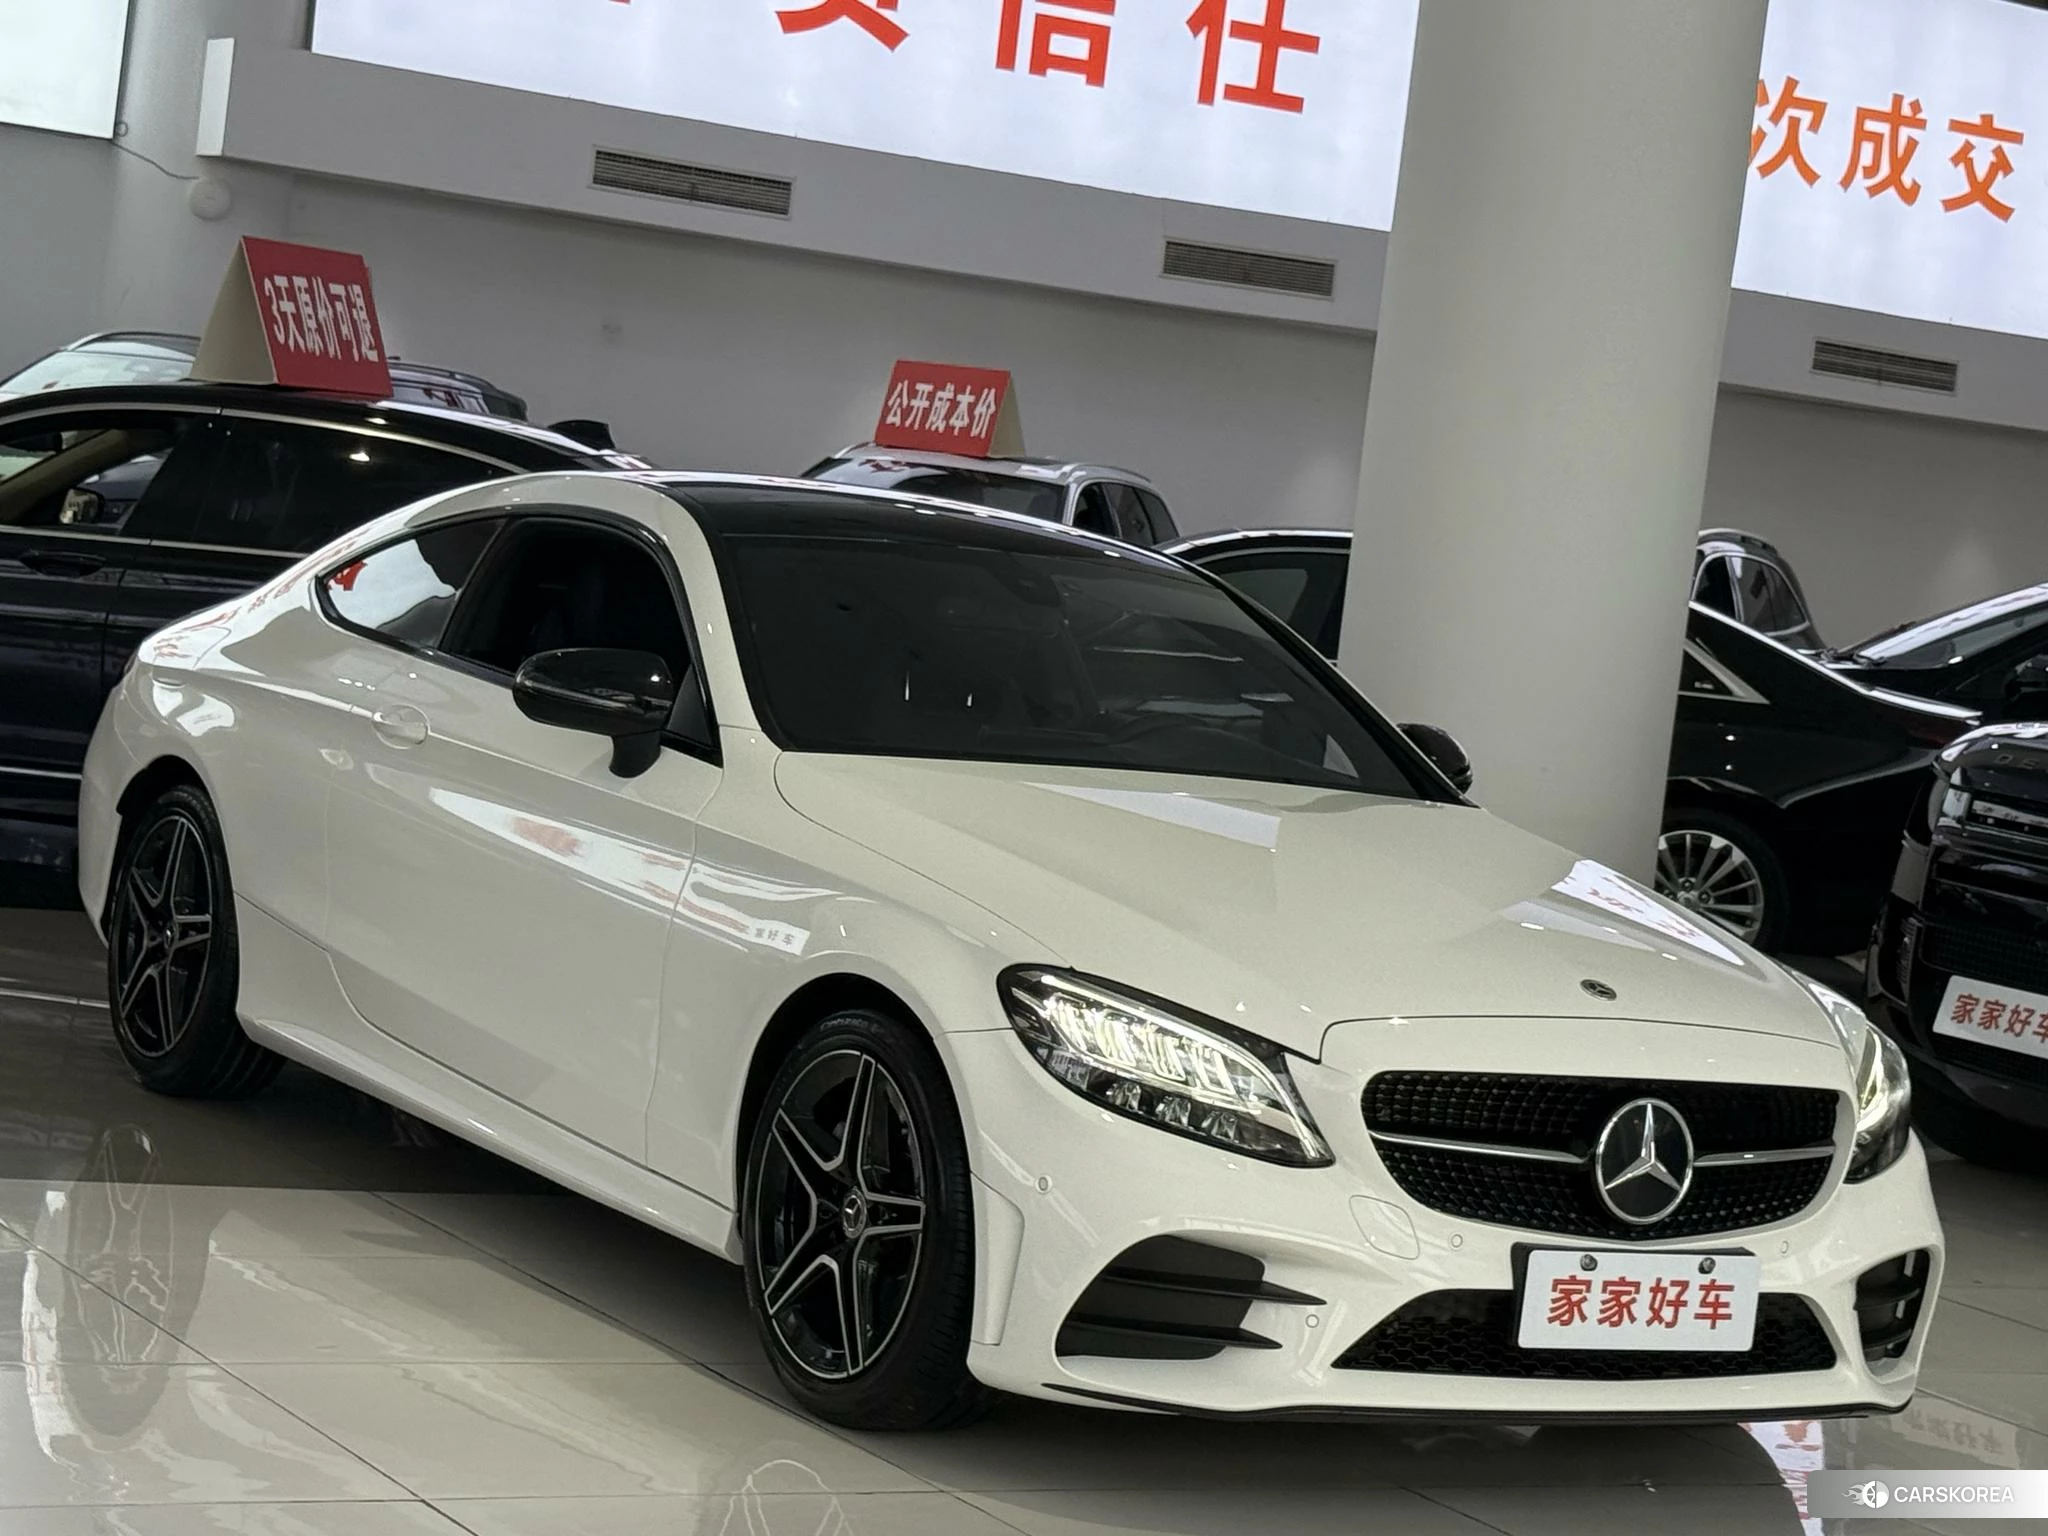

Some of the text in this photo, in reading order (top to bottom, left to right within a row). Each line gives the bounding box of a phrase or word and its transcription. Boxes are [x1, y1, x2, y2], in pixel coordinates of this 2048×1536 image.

[778, 0, 1321, 114] 信任
[1749, 76, 2024, 222] 次成交
[264, 275, 379, 362] 3天原价可退
[885, 380, 996, 439] 公开成本价
[1547, 1275, 1735, 1330] 家家好车
